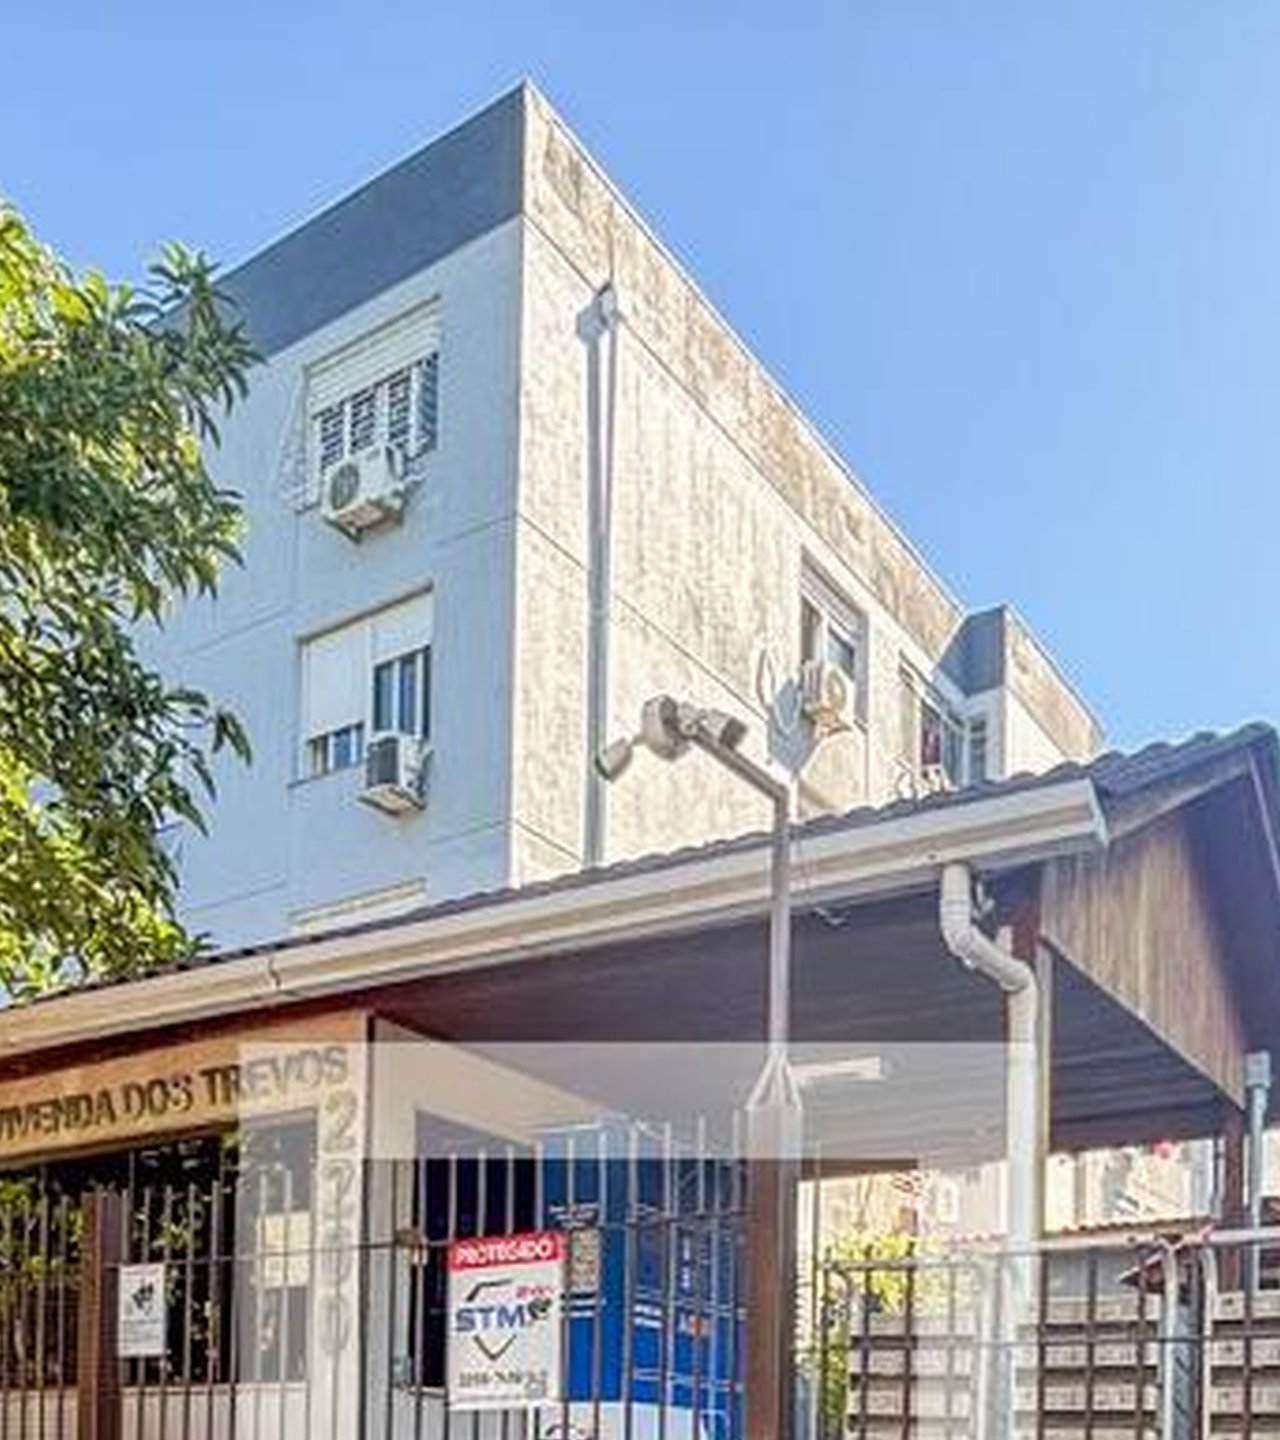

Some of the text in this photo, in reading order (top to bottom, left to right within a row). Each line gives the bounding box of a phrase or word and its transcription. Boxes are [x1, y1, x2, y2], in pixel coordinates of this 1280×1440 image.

[121, 1076, 194, 1119] DOS
[200, 1046, 349, 1103] TREVOS
[456, 1238, 554, 1265] PROTEGIDO
[456, 1304, 525, 1332] STM
